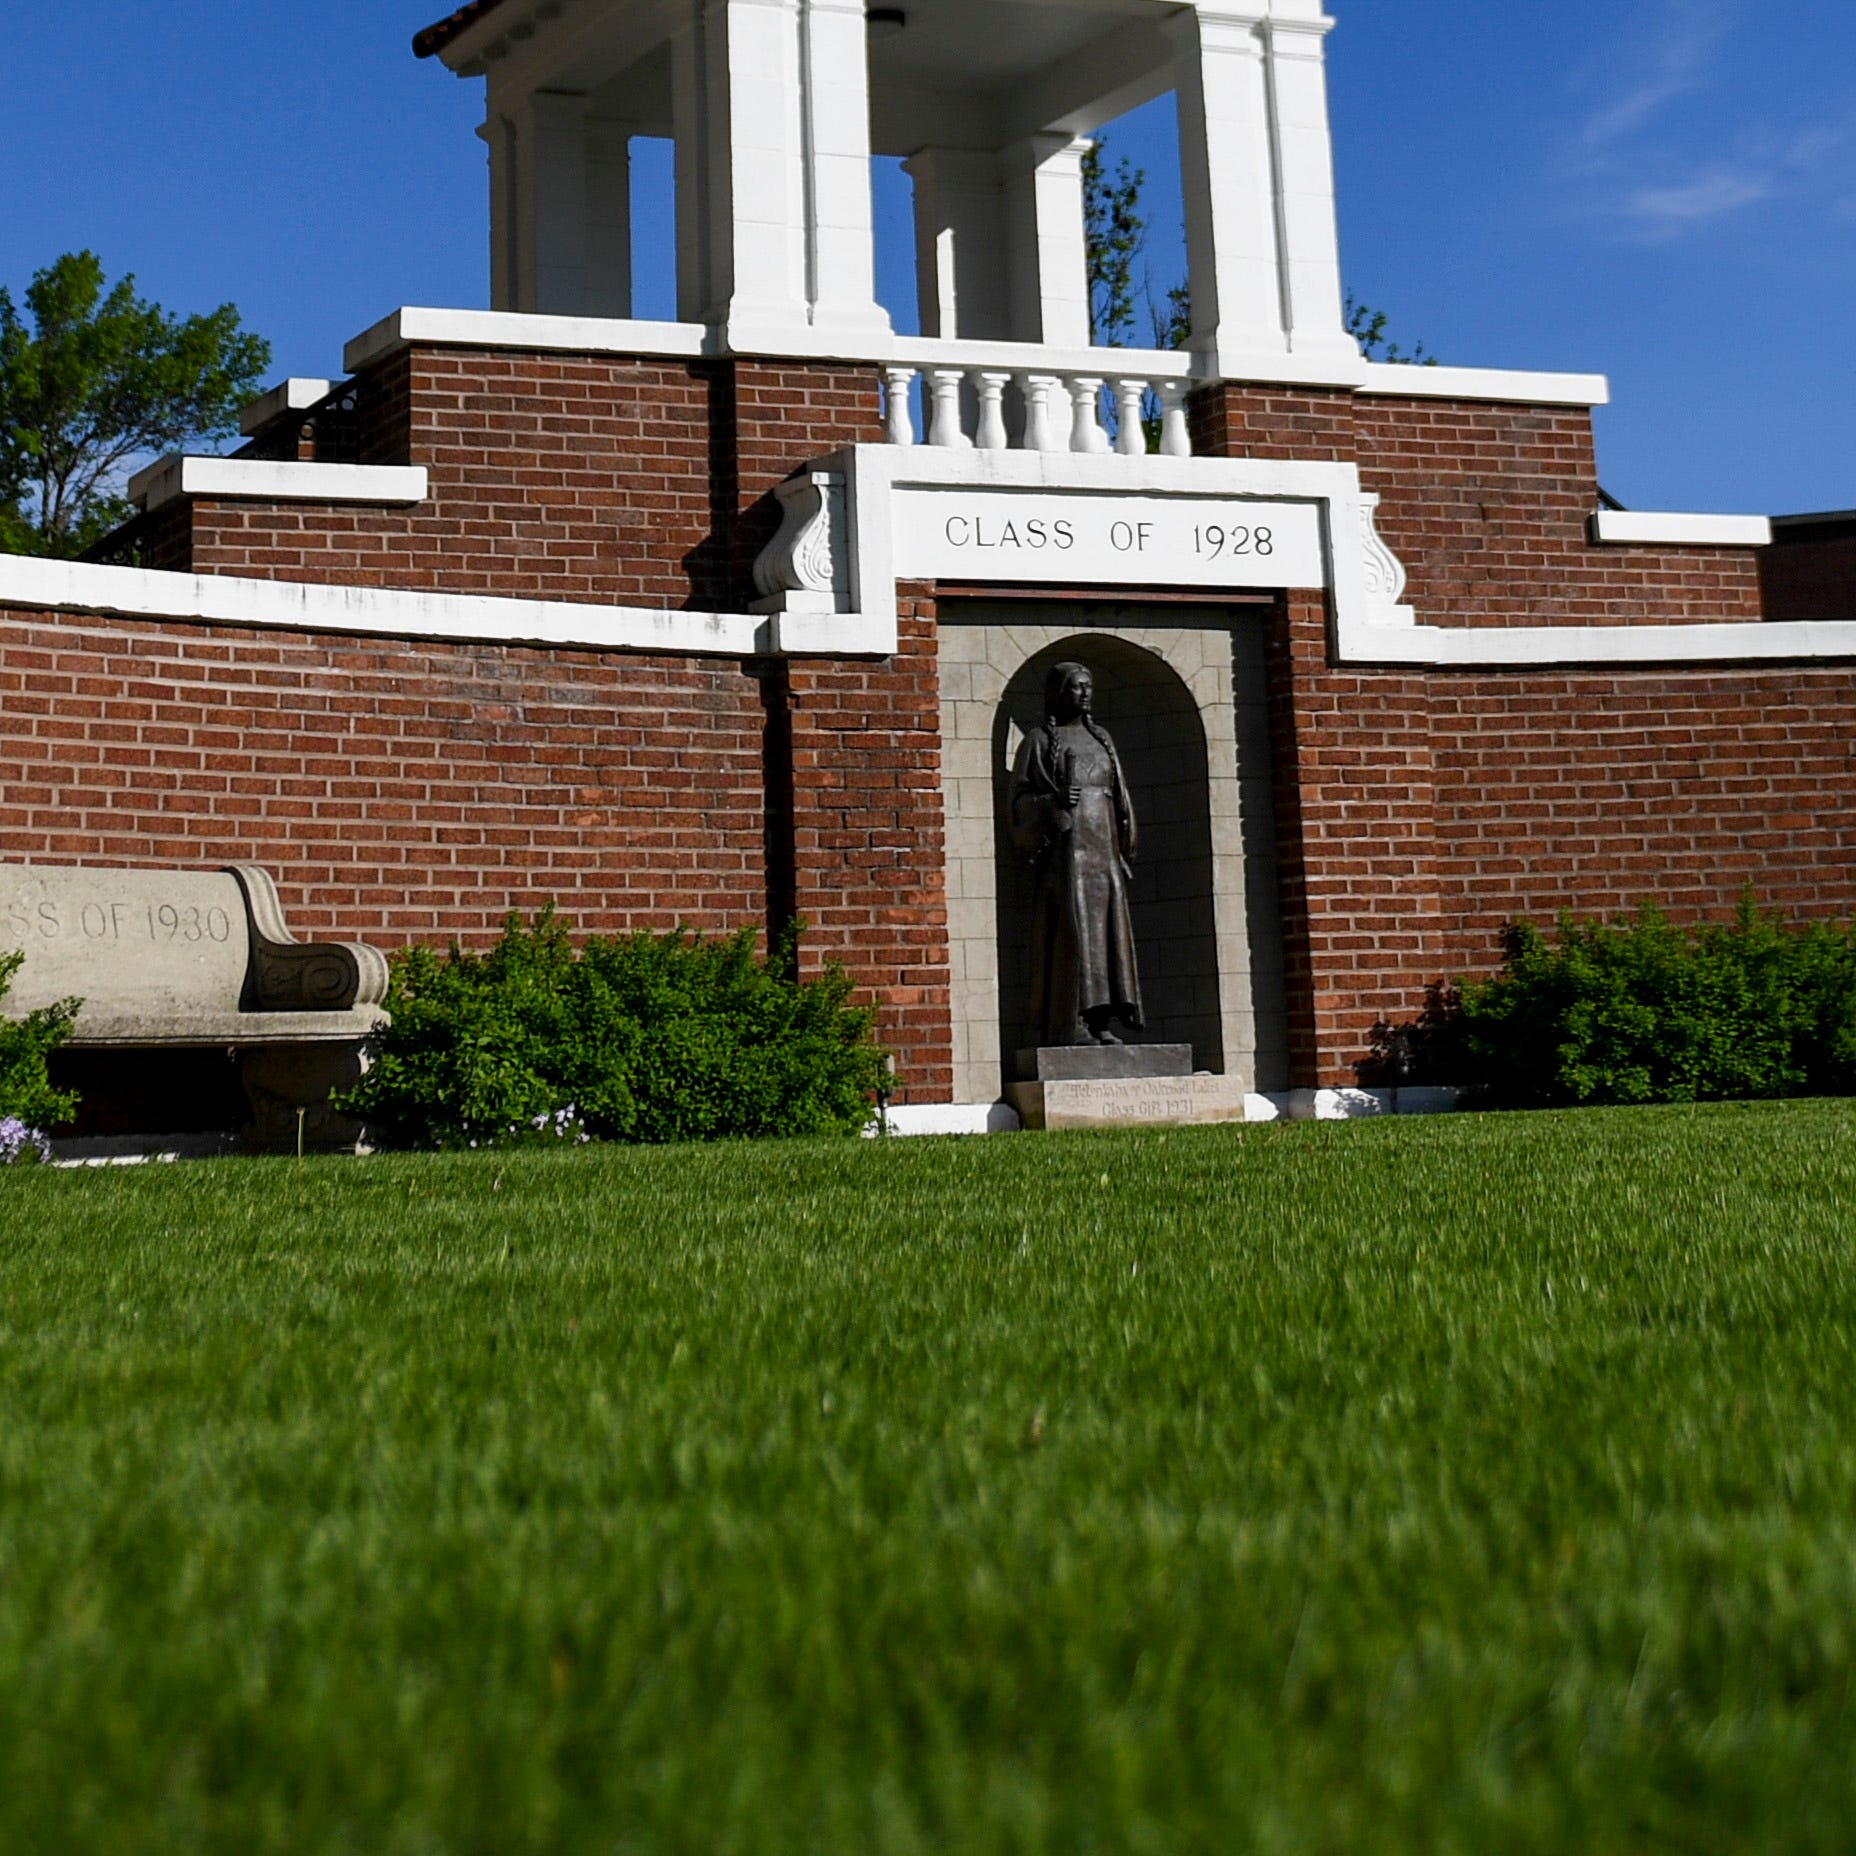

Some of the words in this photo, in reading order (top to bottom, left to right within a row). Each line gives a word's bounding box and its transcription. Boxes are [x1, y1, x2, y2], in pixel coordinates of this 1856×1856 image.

[945, 515, 1074, 550] CLASS
[1110, 521, 1154, 552] OF
[1194, 524, 1274, 560] 1928
[81, 902, 128, 941] OF
[148, 904, 231, 943] 1930
